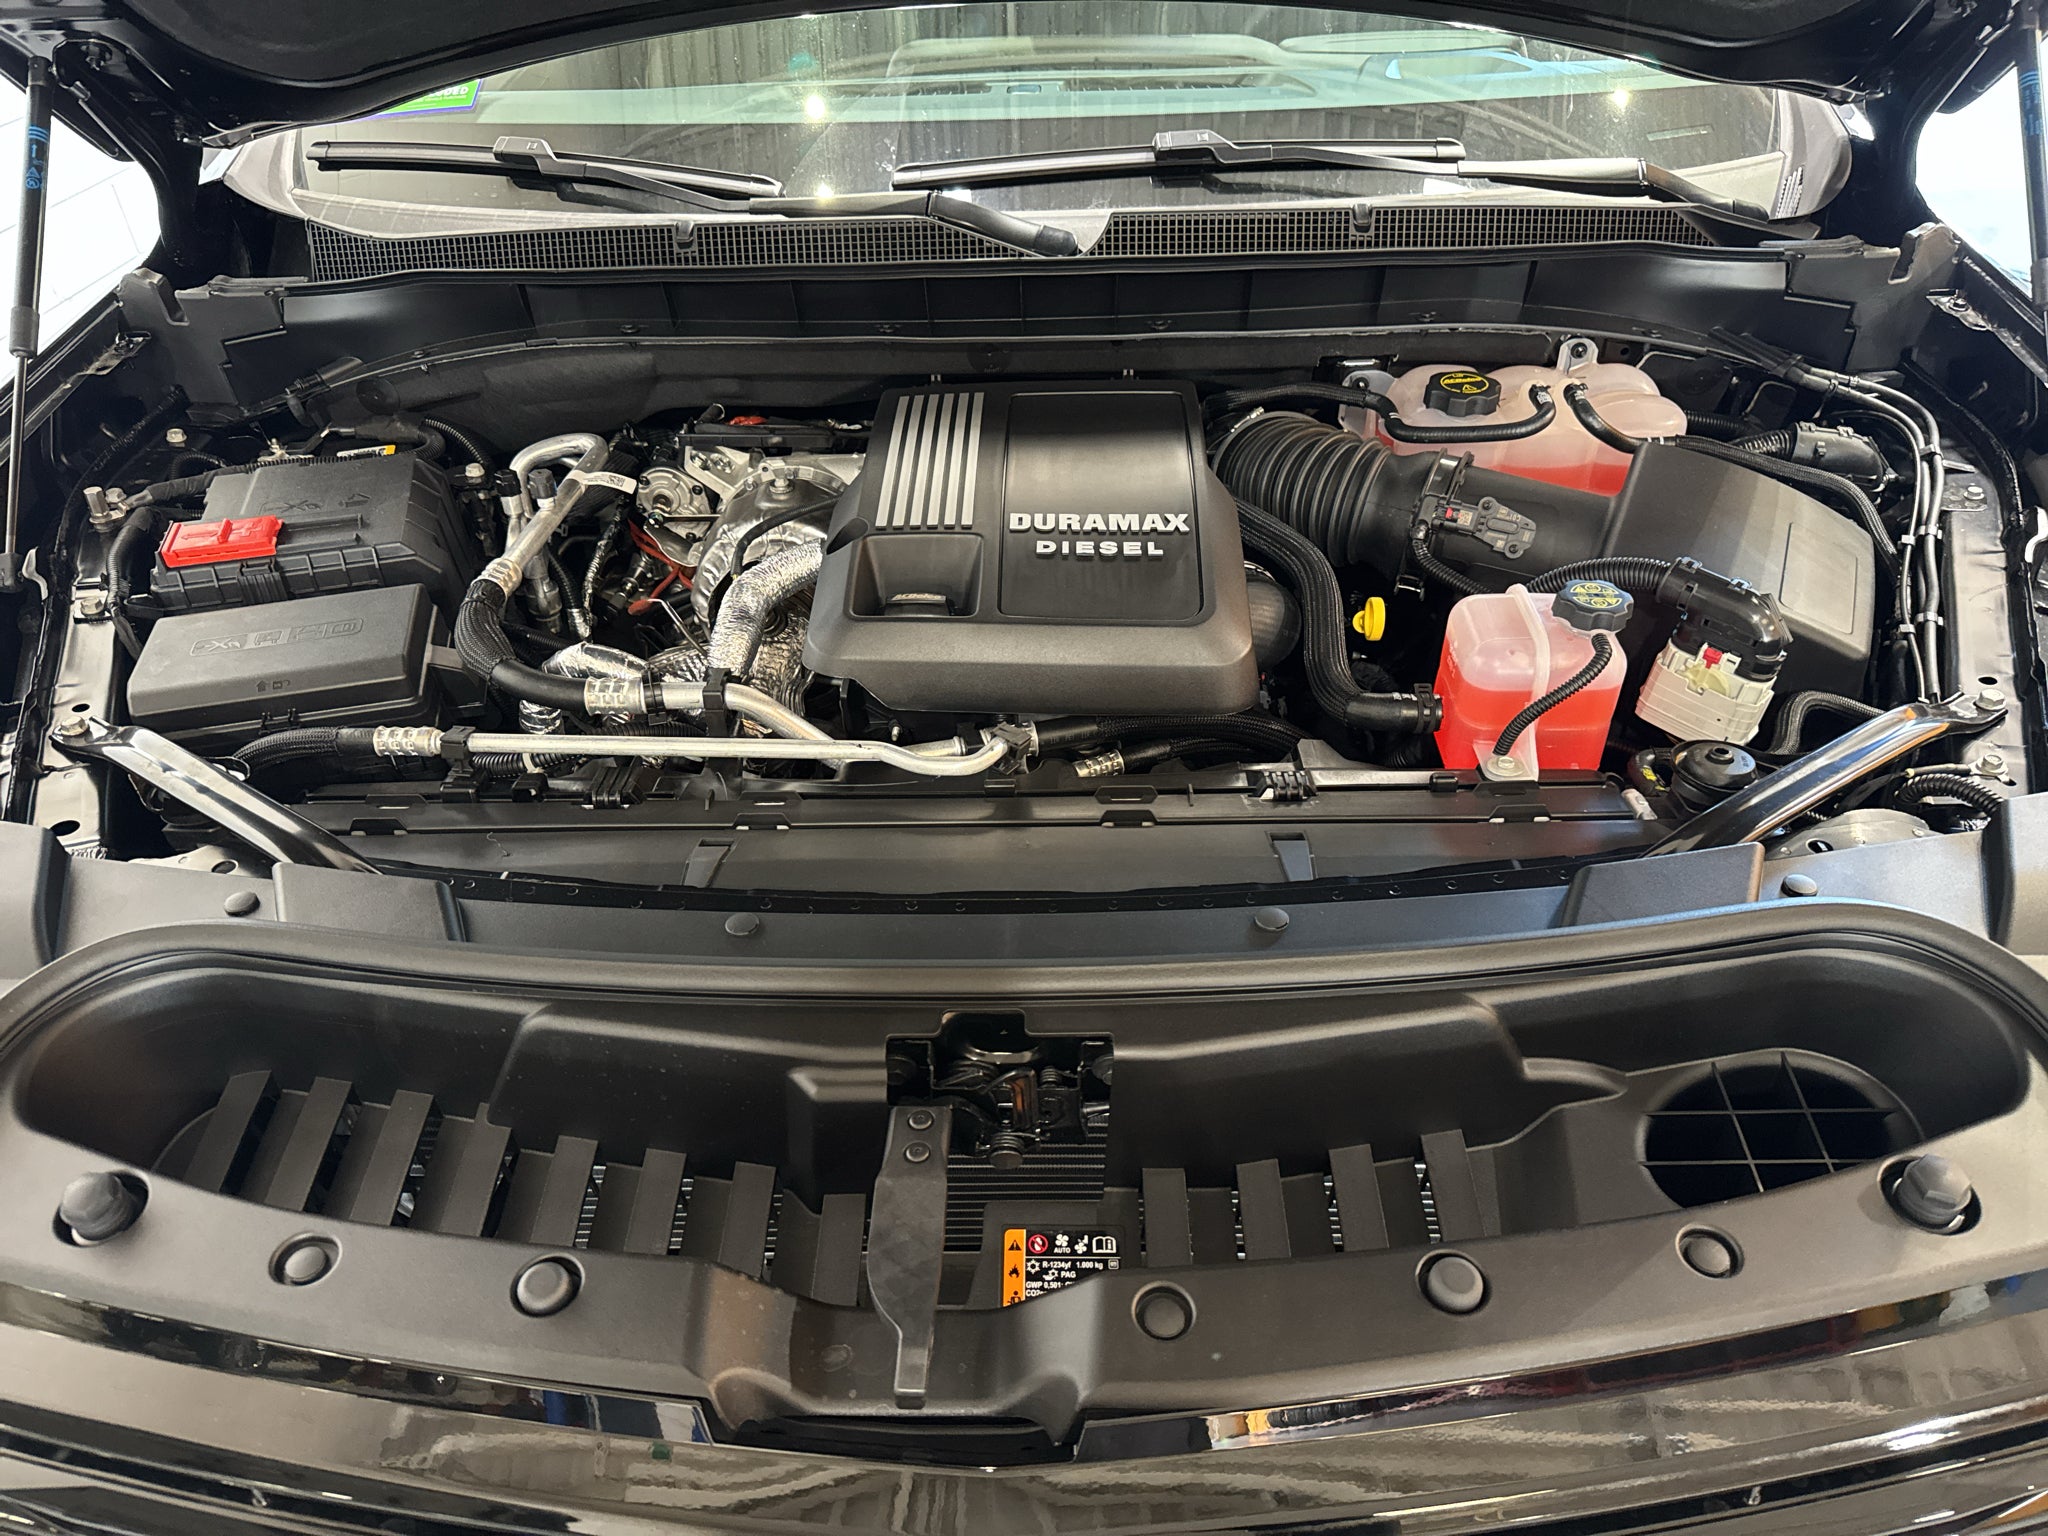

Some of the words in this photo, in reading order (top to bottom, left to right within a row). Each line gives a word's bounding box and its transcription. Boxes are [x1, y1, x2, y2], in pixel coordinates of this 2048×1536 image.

[1008, 512, 1190, 533] DURAMAX
[1035, 540, 1164, 557] DIESEL
[1042, 1261, 1072, 1270] R-1234yf
[1094, 1261, 1104, 1270] kg
[1060, 1270, 1077, 1279] PAG
[1025, 1281, 1042, 1289] GWP
